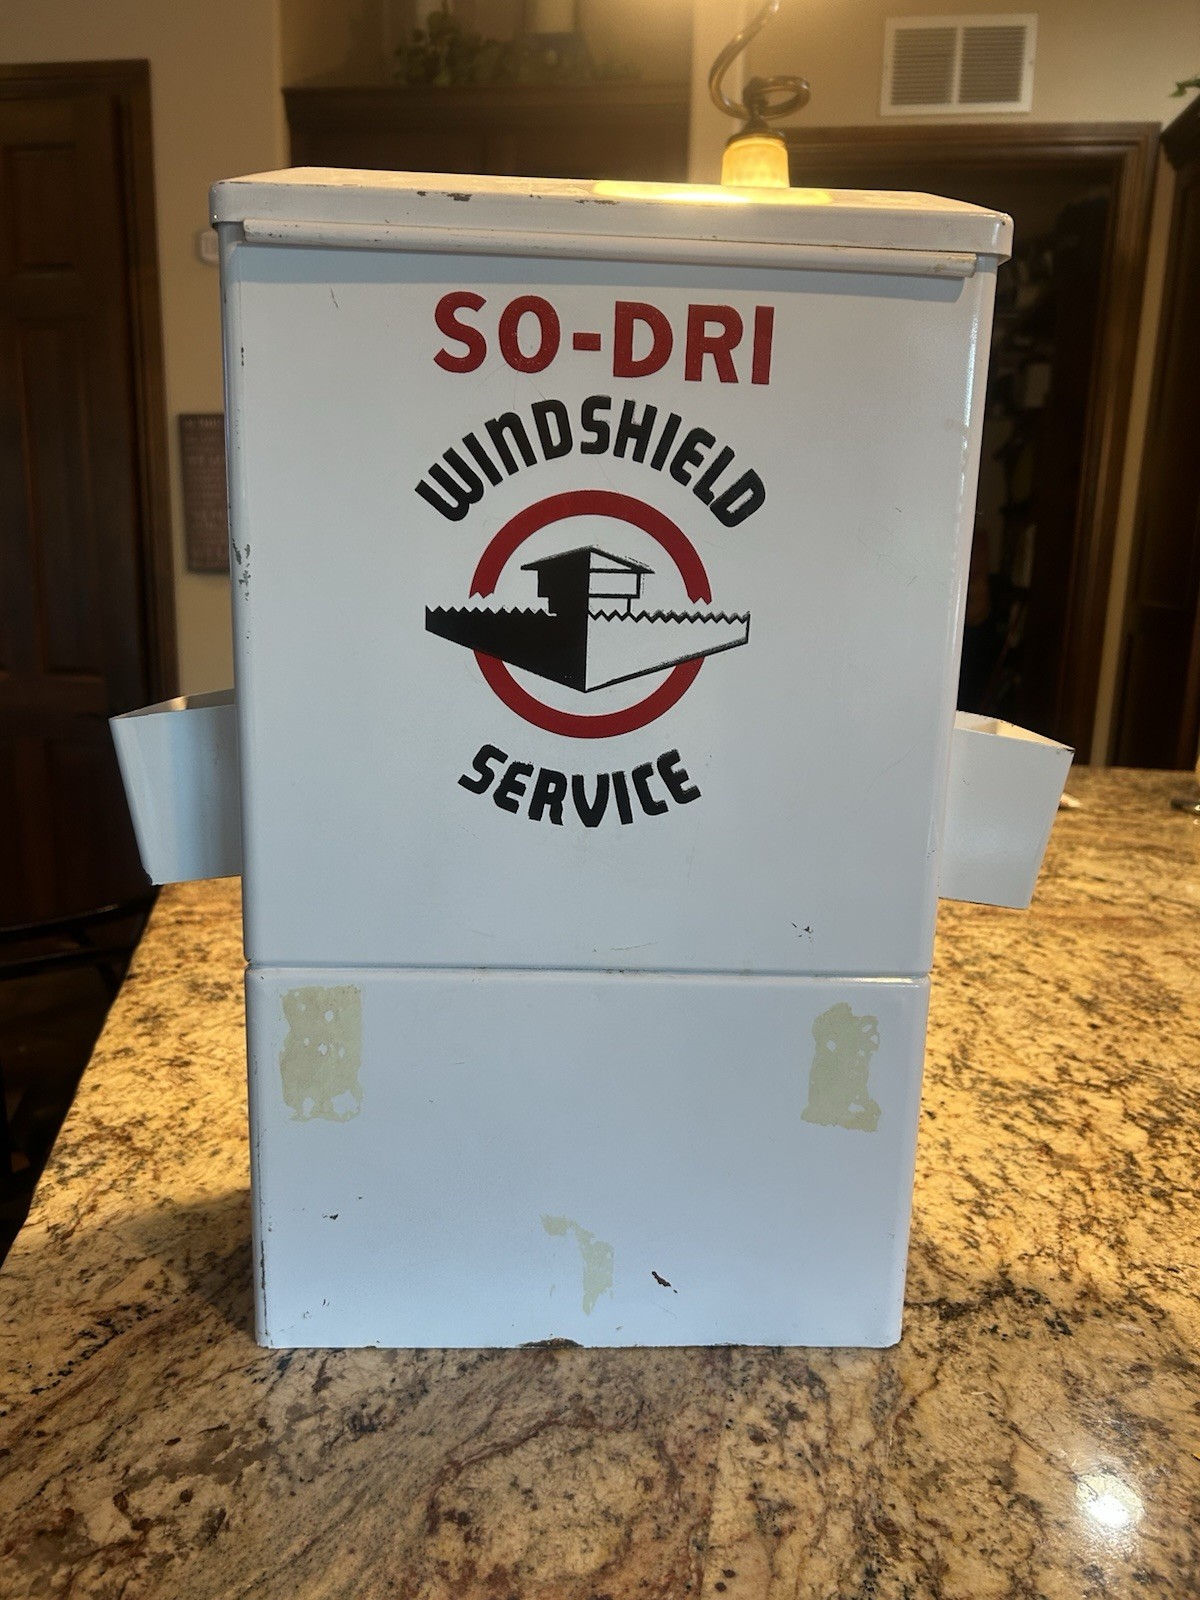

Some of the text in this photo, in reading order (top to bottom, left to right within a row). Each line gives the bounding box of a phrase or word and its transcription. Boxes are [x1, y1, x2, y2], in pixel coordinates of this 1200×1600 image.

[433, 291, 775, 386] SO-DRI
[414, 395, 766, 528] WINDSHIELD
[457, 744, 702, 828] SERVICE
